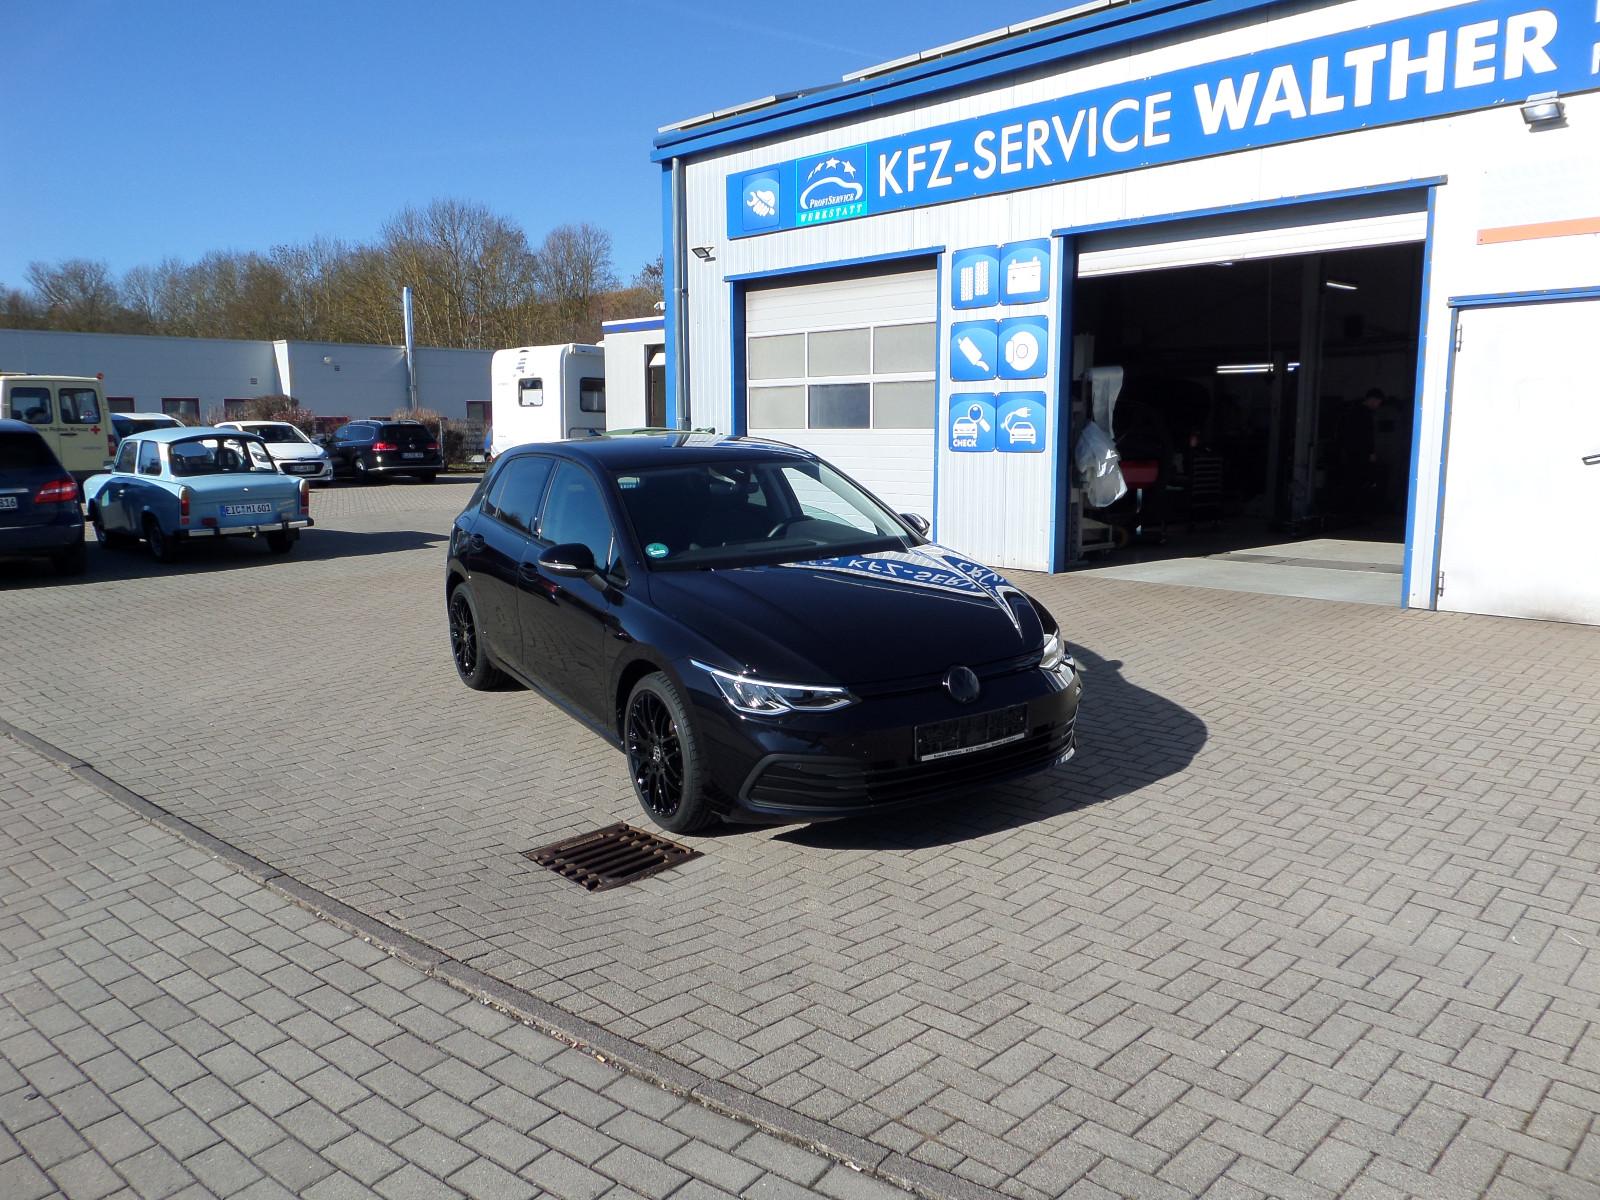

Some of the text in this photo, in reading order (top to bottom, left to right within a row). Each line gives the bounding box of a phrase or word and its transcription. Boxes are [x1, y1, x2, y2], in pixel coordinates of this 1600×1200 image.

[879, 9, 1559, 197] KFZ-SERVICE WALTHER
[800, 204, 863, 222] WERKSTATT
[952, 438, 977, 448] CHECK
[225, 503, 271, 515] EIC MI 601
